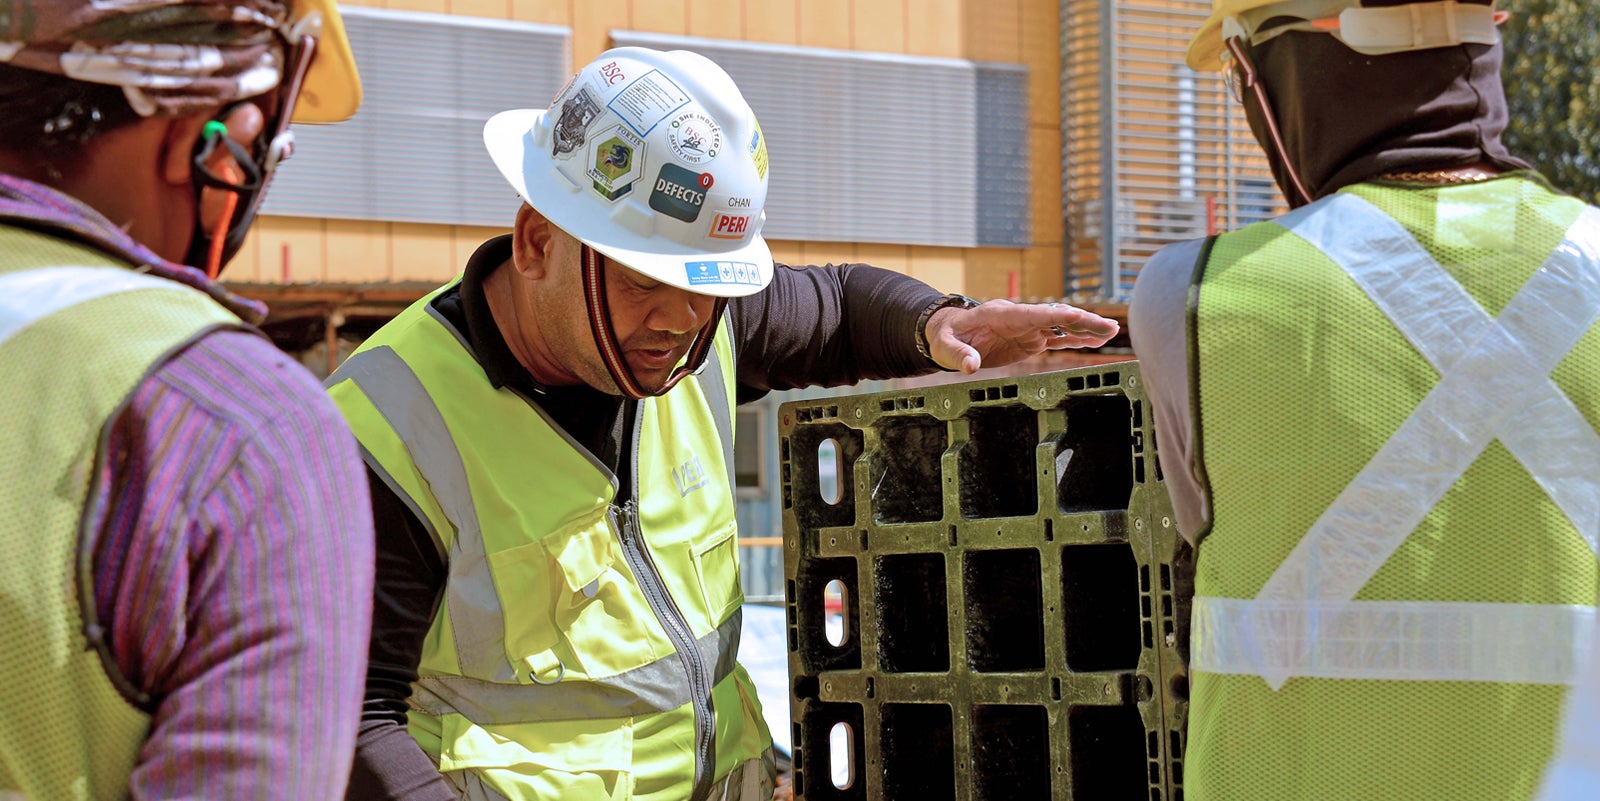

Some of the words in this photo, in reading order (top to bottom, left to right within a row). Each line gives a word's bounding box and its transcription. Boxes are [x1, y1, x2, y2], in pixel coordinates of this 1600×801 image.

[601, 61, 625, 85] BSC
[617, 126, 641, 146] FORTIS
[679, 113, 694, 122] SHE
[696, 114, 720, 149] INDUCTED
[685, 127, 707, 143] BSC
[669, 134, 684, 156] SAFETY
[683, 154, 701, 163] FIRST
[656, 178, 704, 206] DEFECTS
[728, 197, 751, 208] CHAN
[717, 215, 750, 233] PERI
